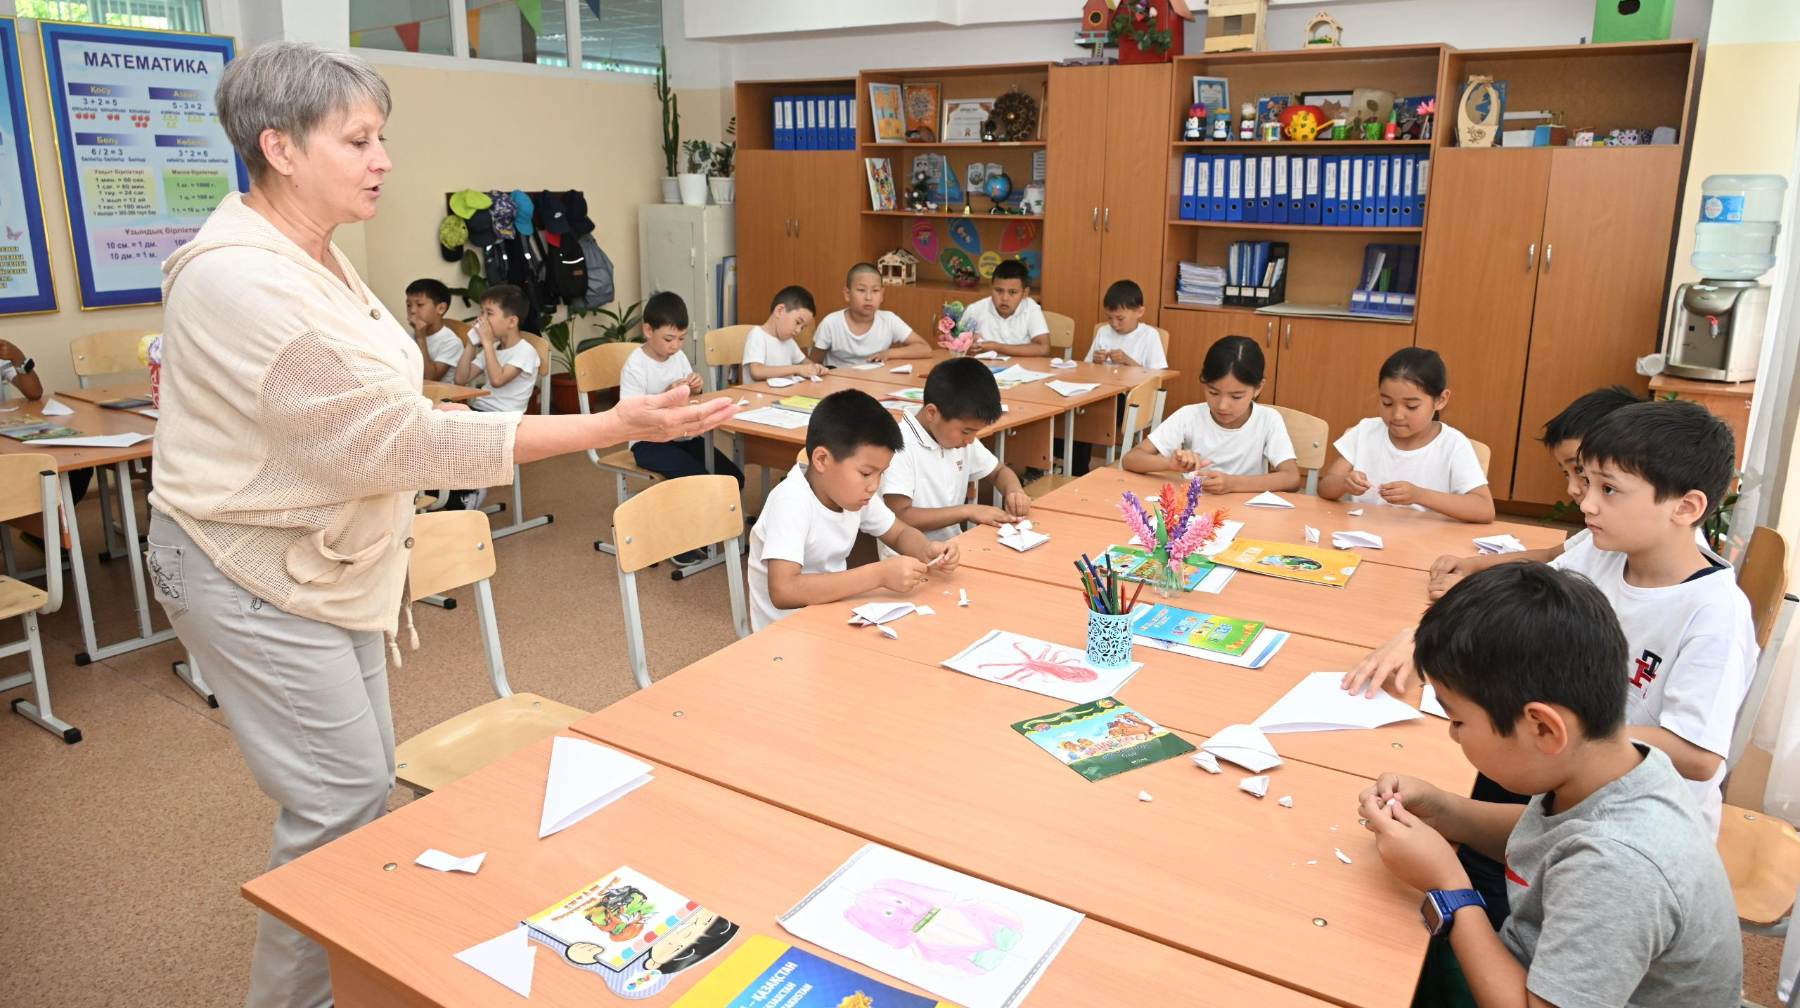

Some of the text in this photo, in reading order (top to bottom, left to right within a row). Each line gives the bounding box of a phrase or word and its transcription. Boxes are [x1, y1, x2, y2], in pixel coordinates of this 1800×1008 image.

[83, 51, 208, 74] МАТЕМАТИКА
[90, 85, 111, 95] Қосу
[124, 228, 163, 236] Ұзындық
[110, 252, 119, 260] 10
[751, 961, 799, 1002] ҚАЗАҚСТАН
